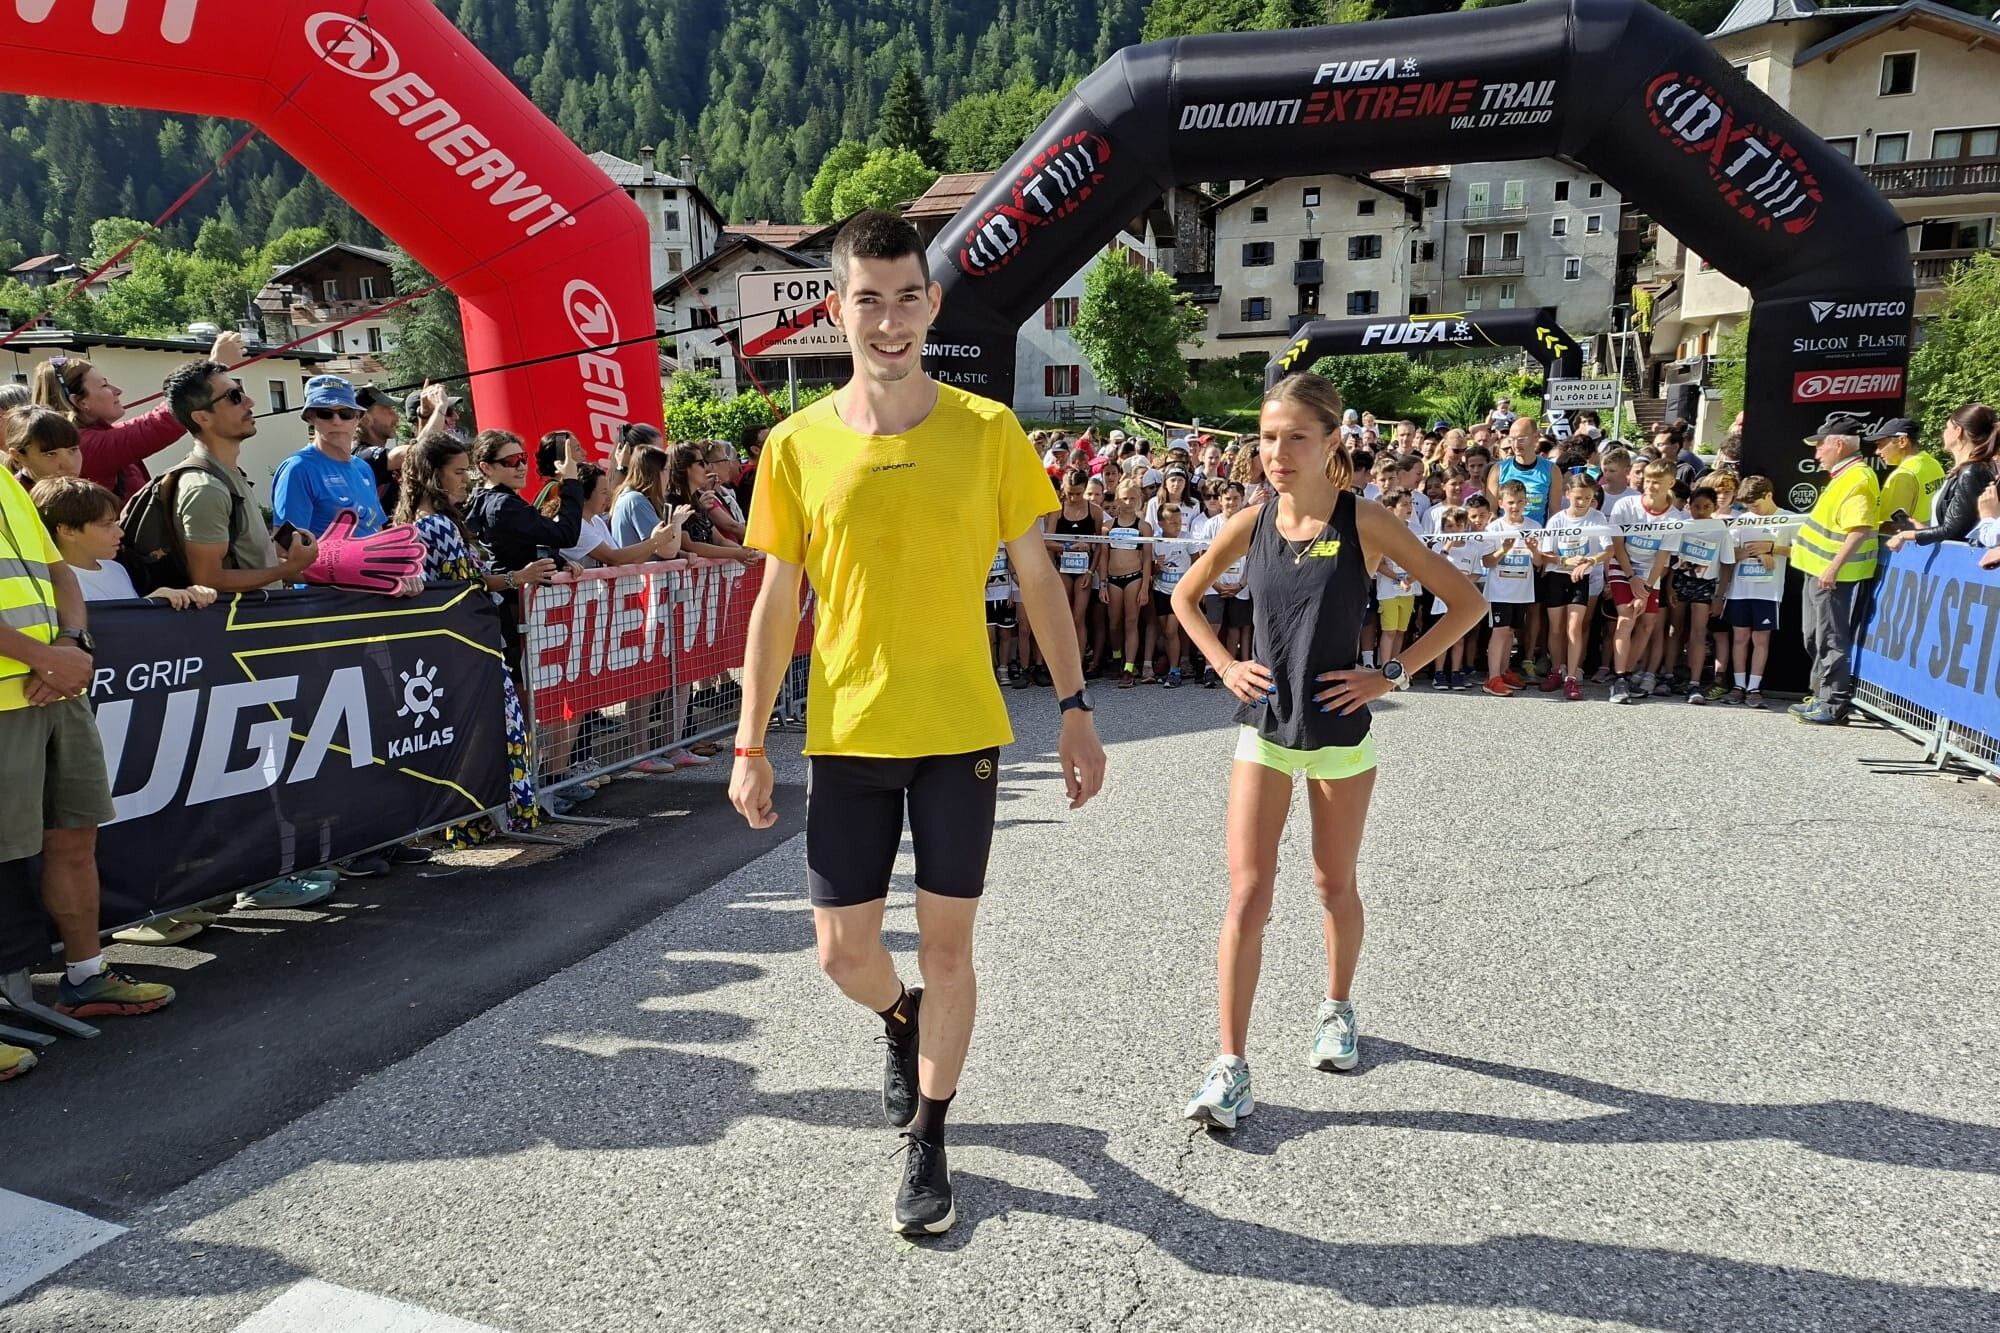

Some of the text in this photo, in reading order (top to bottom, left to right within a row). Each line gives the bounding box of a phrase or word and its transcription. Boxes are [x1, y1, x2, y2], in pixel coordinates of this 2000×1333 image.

[1313, 58, 1396, 84] FUGA
[1178, 79, 1556, 131] DOLOMITI EXTREME TRAIL
[1450, 109, 1552, 130] VAL DI ZOLDO
[370, 72, 577, 236] ENERVIT
[774, 279, 836, 301] FORN
[775, 309, 805, 329] AL
[1834, 301, 1906, 319] SINTECO
[799, 335, 808, 345] di
[811, 336, 828, 344] VAL
[830, 335, 840, 343] DI
[1361, 320, 1447, 346] FUGA
[921, 344, 981, 358] SINTECO
[1792, 337, 1849, 353] SILCON
[939, 370, 988, 384] PLASTIC
[1829, 374, 1901, 395] ENERVIT
[1633, 522, 1684, 532] SINTECO
[1737, 516, 1789, 526] SINTECO
[1533, 527, 1582, 538] SINTECO
[527, 561, 746, 690] ENERVIT
[1864, 567, 1941, 670] ADY
[126, 656, 203, 692] GRIP
[95, 666, 374, 828] UGA
[388, 727, 455, 760] KAILAS
